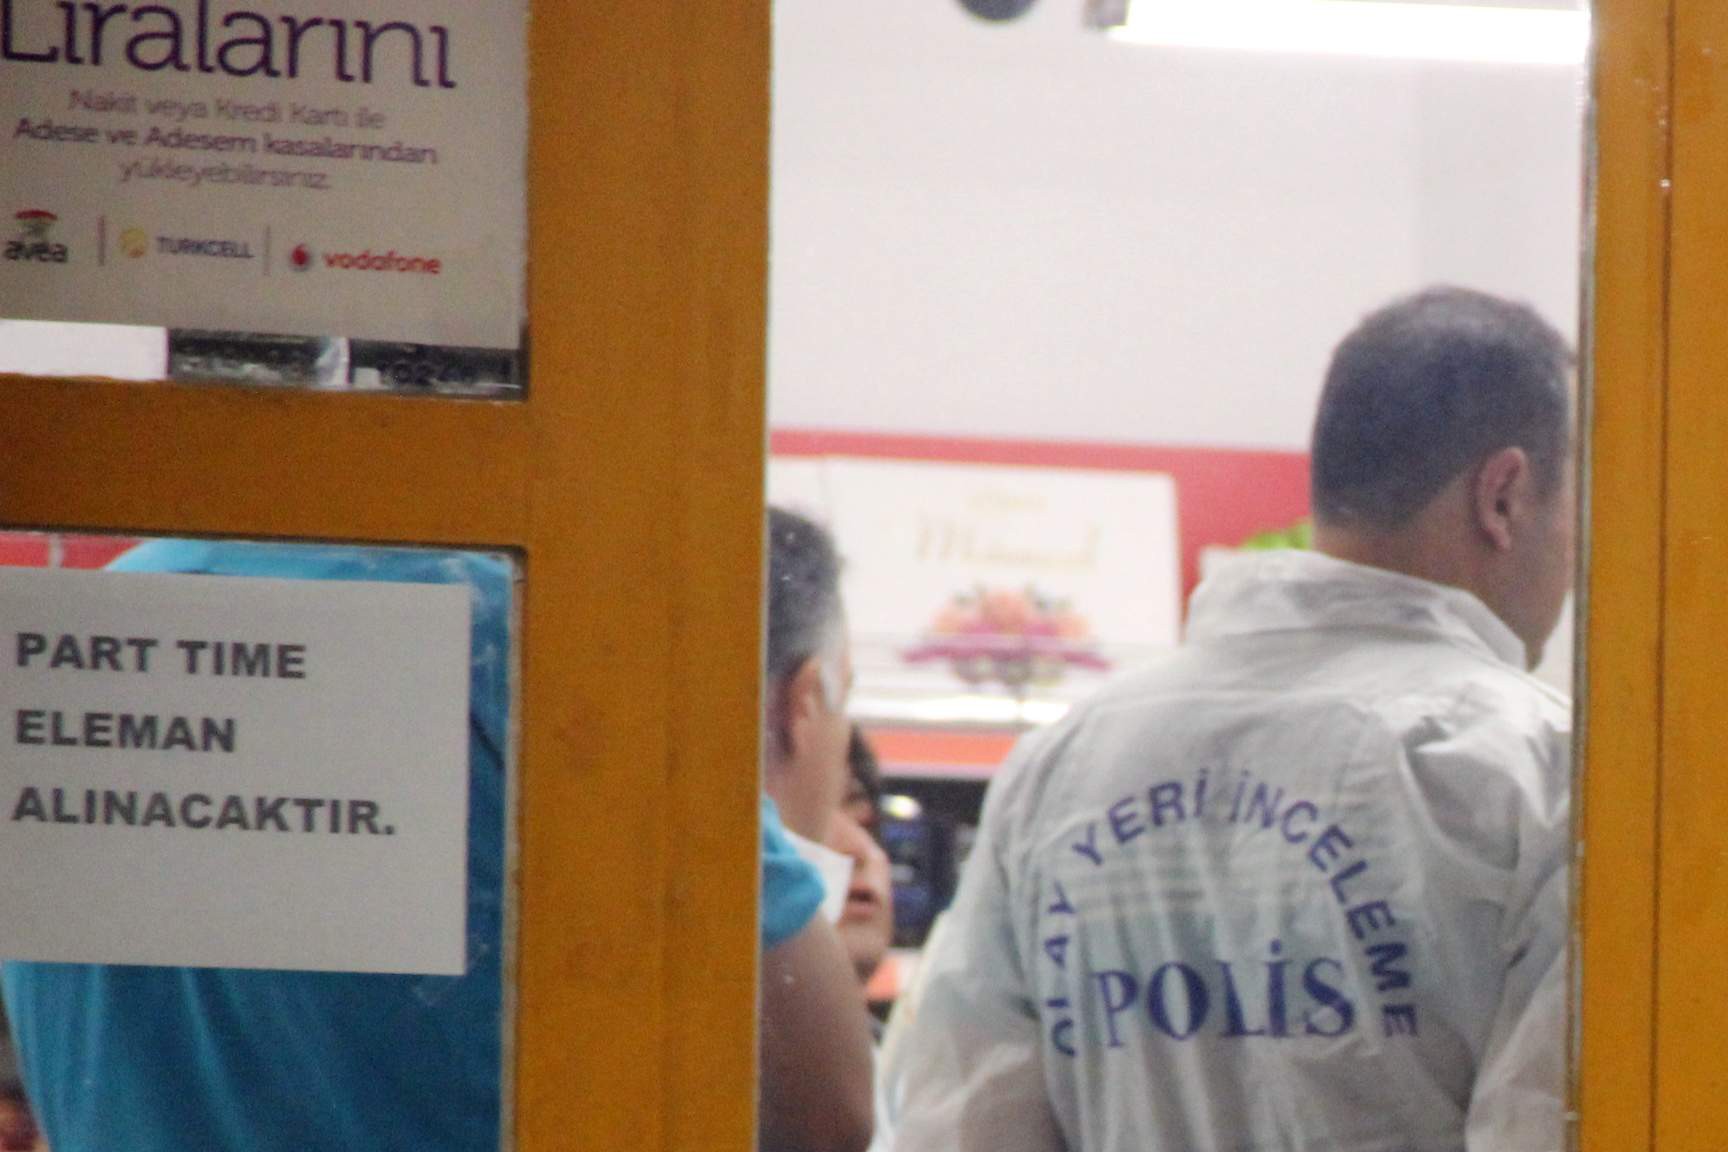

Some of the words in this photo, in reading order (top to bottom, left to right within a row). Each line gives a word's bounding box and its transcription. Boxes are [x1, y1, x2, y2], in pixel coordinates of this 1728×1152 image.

[13, 117, 98, 142] Adese
[105, 128, 137, 145] ve
[143, 126, 256, 153] Adesem
[3, 240, 69, 263] avea
[323, 247, 442, 275] vodafone
[16, 632, 158, 672] PART
[178, 639, 306, 680] TIME
[15, 709, 236, 752] ELEMAN
[11, 786, 396, 836] ALINACAKTIR.
[1090, 938, 1357, 1050] POLİS
